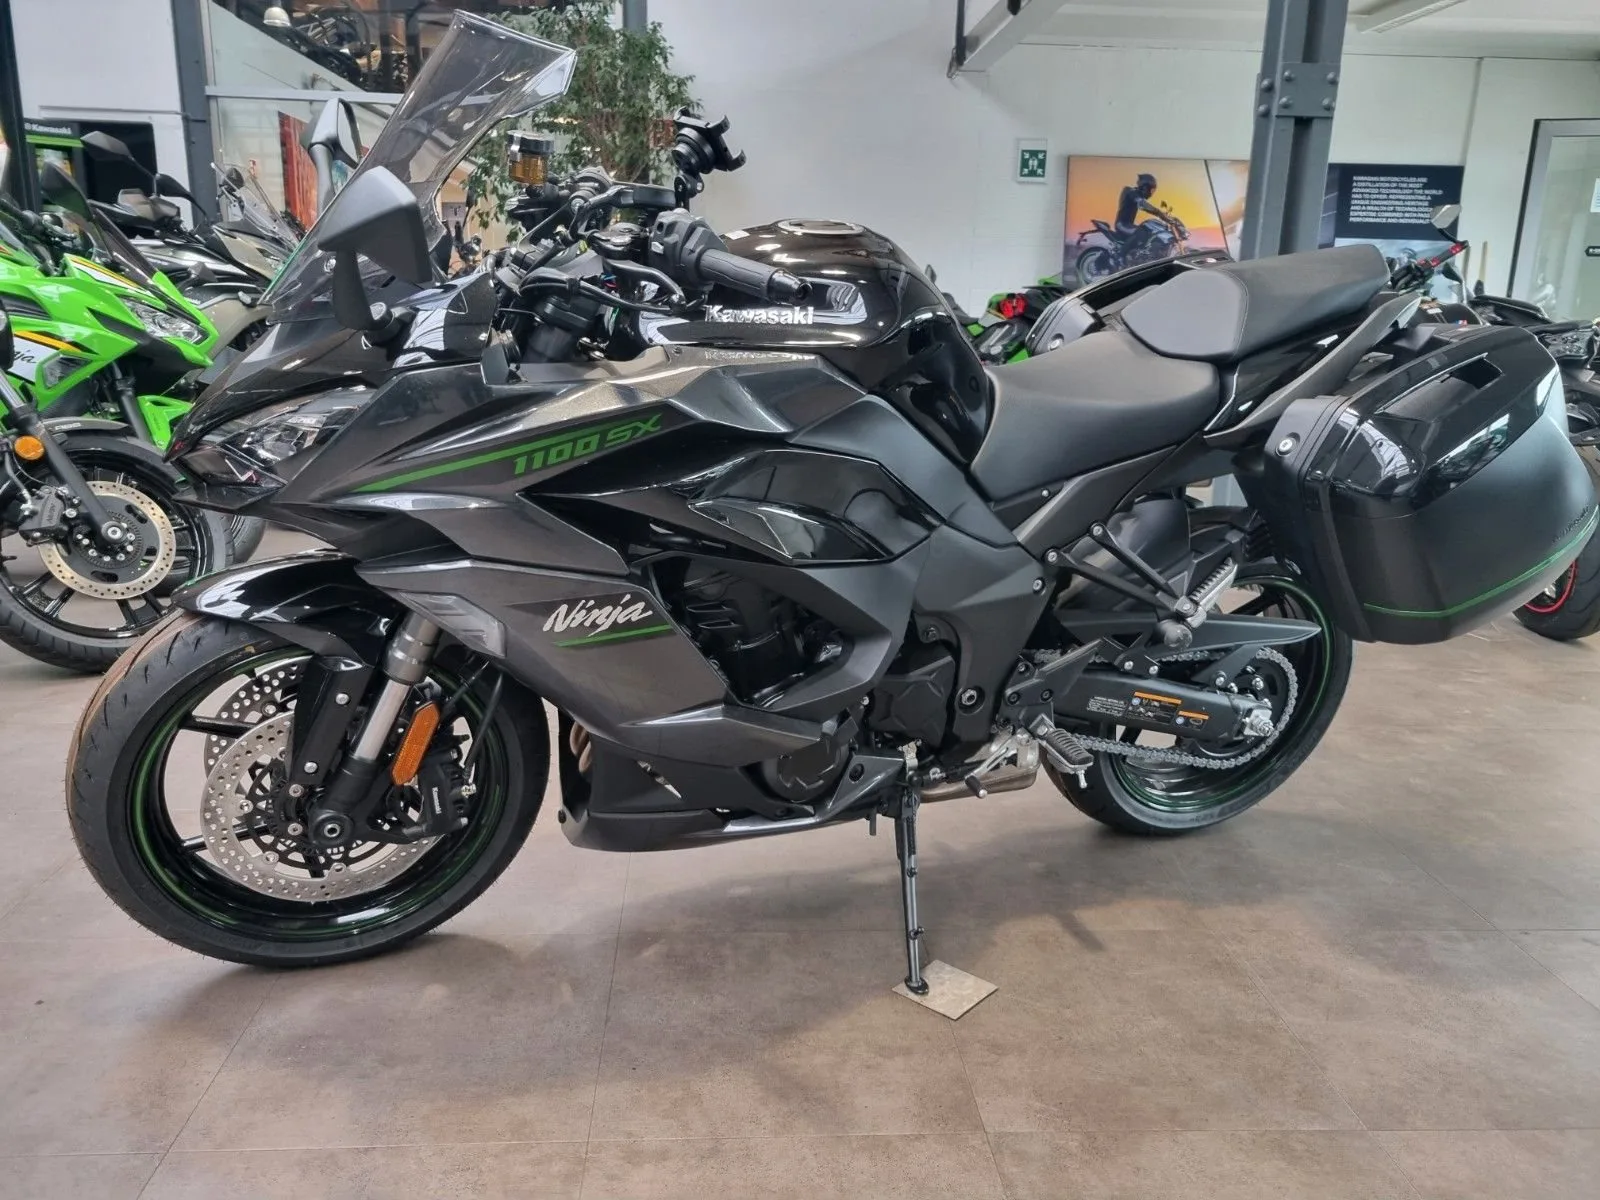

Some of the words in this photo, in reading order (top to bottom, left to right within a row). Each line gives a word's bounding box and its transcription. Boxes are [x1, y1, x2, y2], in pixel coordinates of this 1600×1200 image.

[31, 123, 72, 134] Kawasaki
[702, 304, 814, 325] Kawasaki
[513, 433, 601, 475] 1100
[604, 412, 663, 448] SX
[542, 593, 653, 637] Ninja
